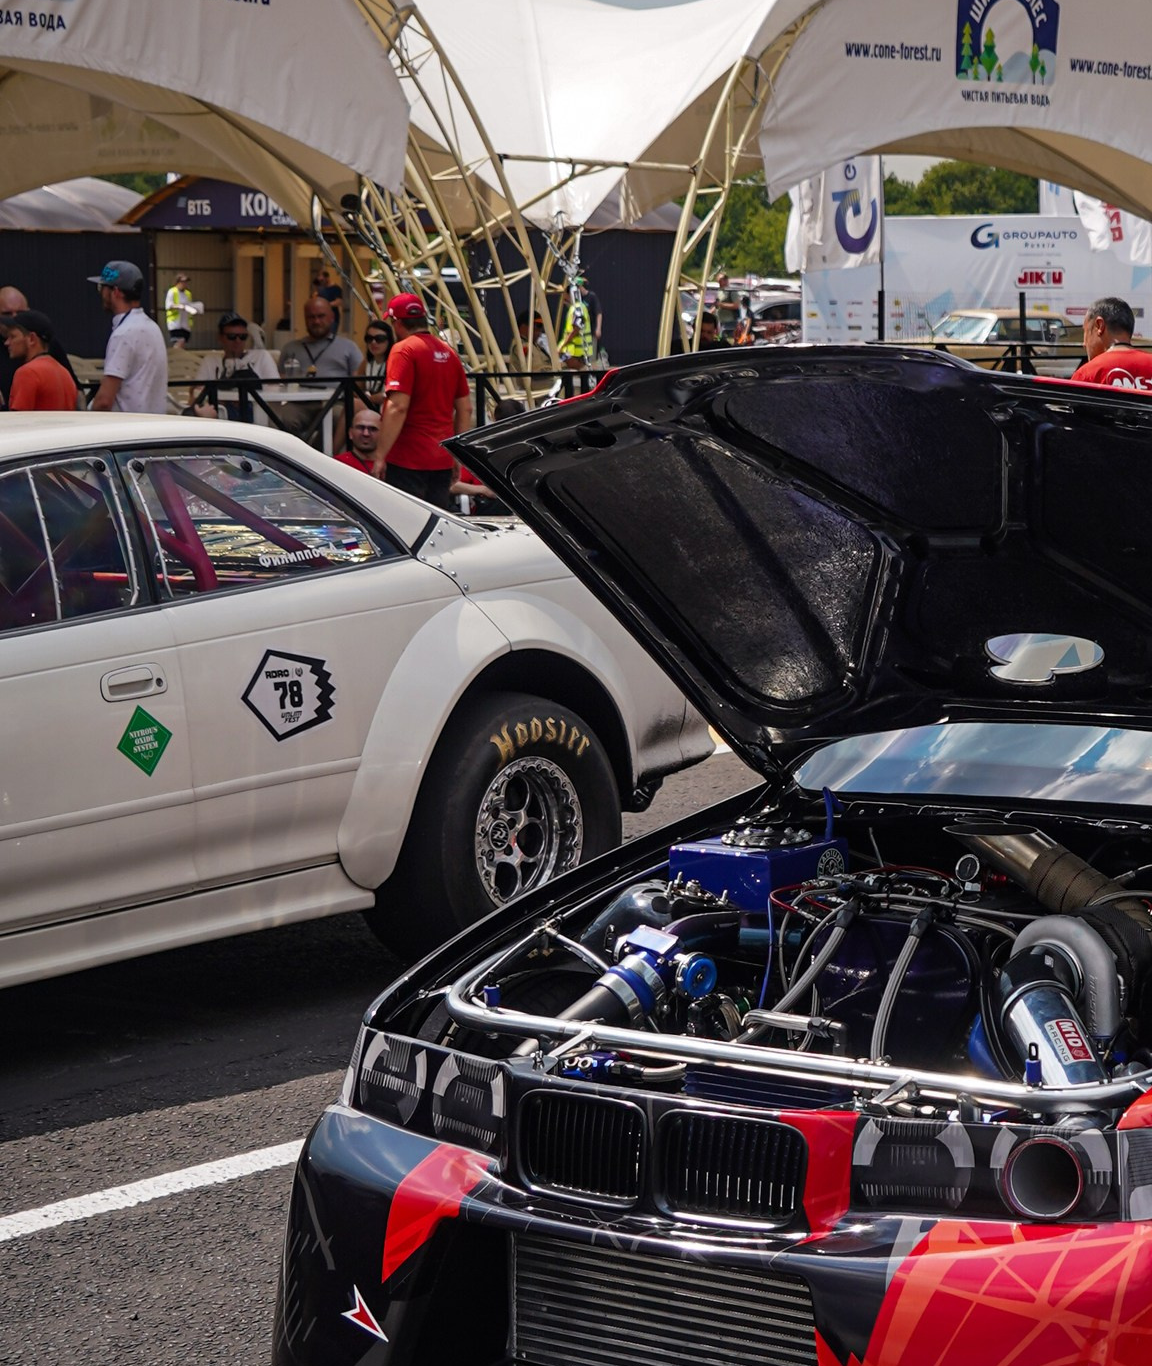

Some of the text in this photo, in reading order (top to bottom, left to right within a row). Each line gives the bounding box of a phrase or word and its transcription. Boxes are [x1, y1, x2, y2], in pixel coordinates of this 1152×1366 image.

[29, 12, 67, 32] ВОДА
[844, 41, 942, 63] www.cone-forest.ru
[961, 89, 1051, 108] ЧИСТАЯ ПИТЬЕВАЯ ВОДА
[187, 198, 212, 216] ВТБ
[1002, 230, 1079, 241] GROUPAUTO
[1017, 271, 1064, 285] JIKIU
[273, 680, 304, 710] 78
[129, 726, 159, 739] NITROUS
[134, 734, 155, 746] OXIDE
[132, 740, 159, 754] SYSTEM
[1048, 1023, 1071, 1063] RACING
